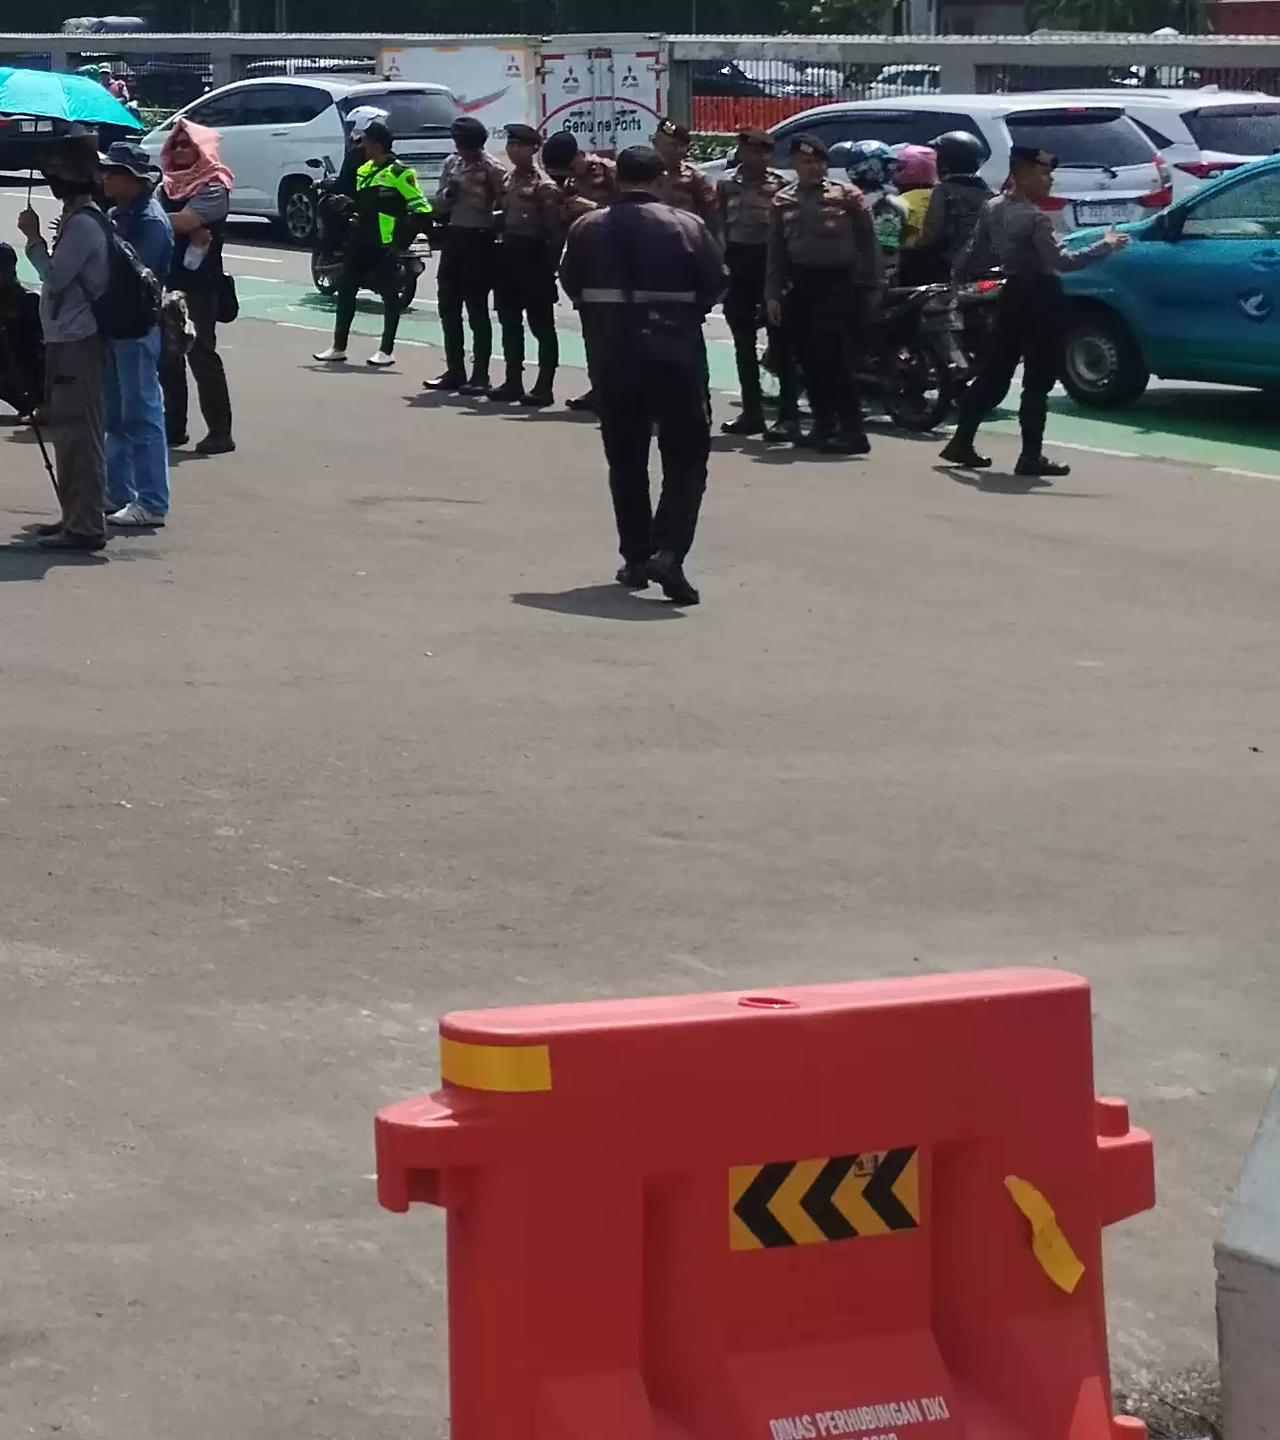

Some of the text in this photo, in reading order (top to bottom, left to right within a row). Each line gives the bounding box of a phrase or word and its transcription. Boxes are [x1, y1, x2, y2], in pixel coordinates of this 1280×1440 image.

[769, 1396, 951, 1440] DINAS PERHUBUNGAN DKI
